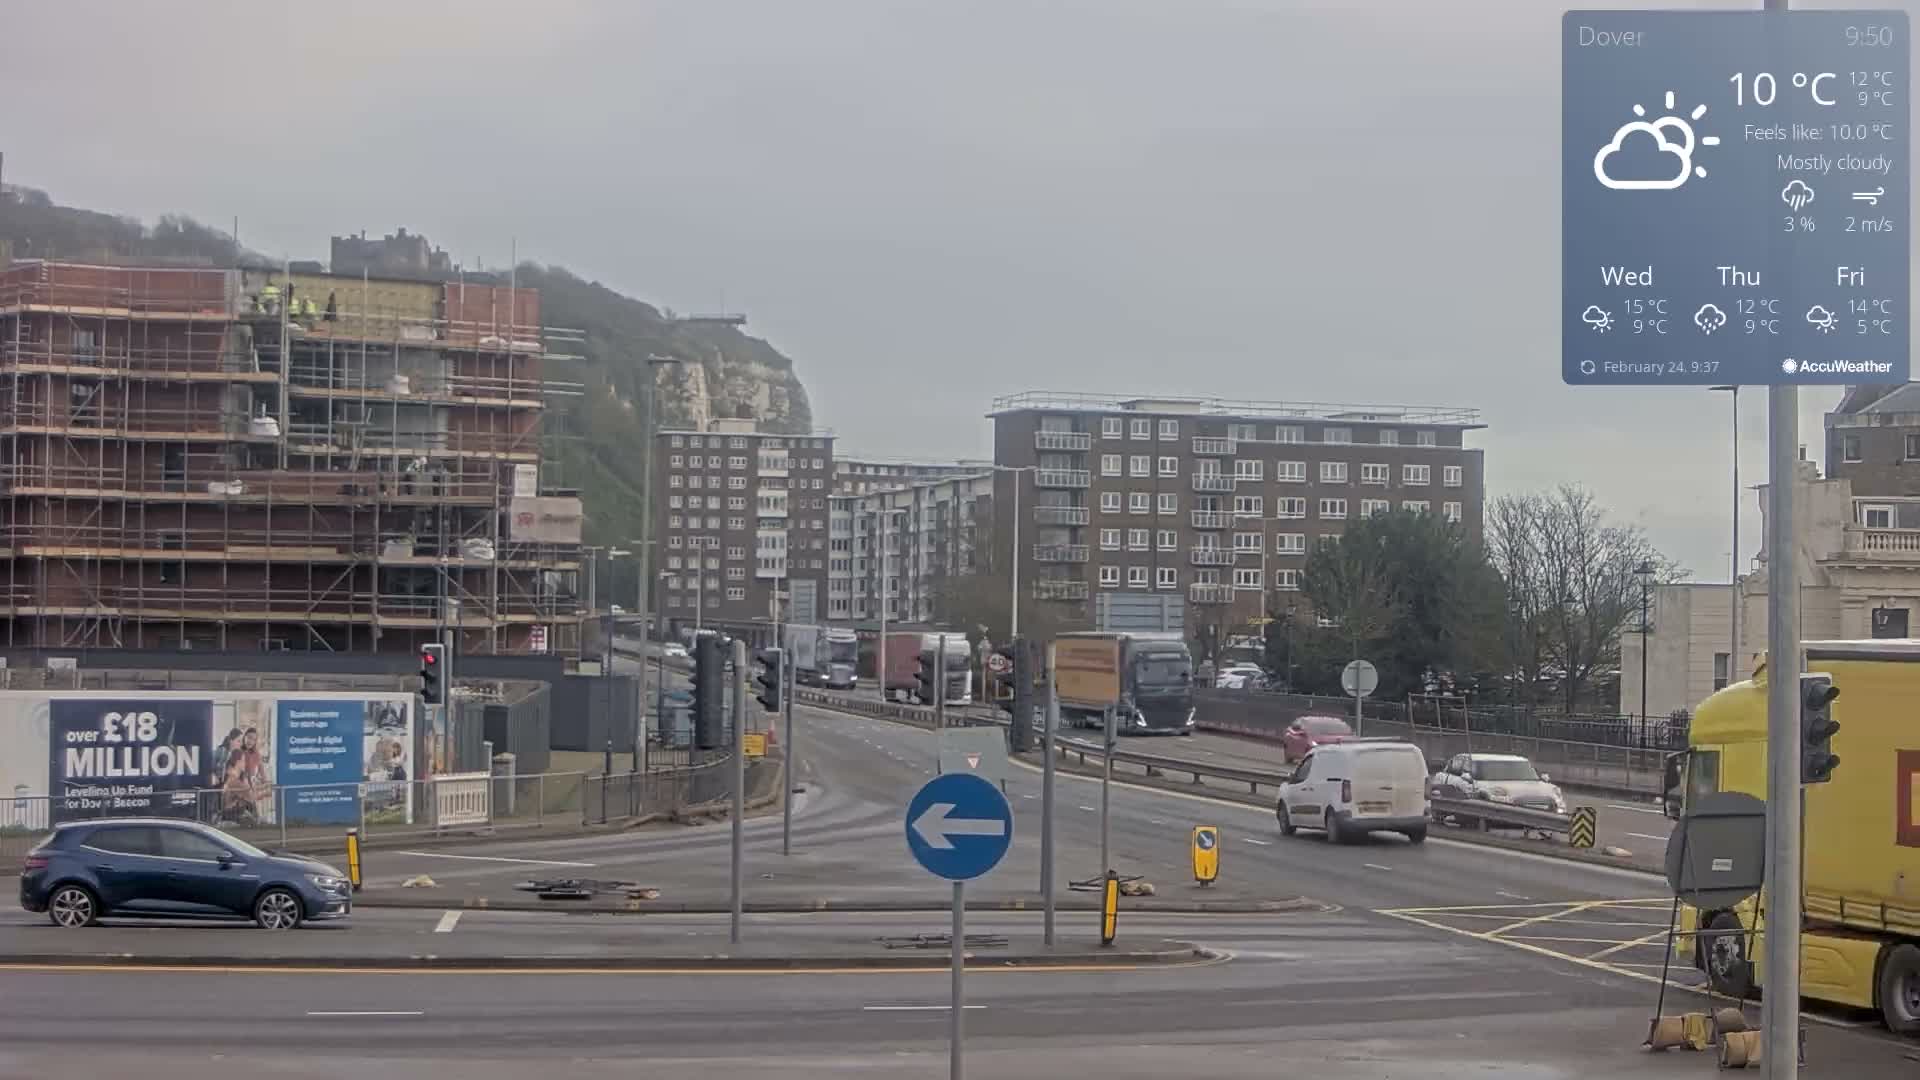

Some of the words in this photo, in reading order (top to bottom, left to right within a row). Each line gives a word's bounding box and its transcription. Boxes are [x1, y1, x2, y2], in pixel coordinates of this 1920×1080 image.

[66, 730, 99, 742] over
[104, 711, 158, 742] £18
[66, 745, 200, 778] MILLION
[65, 786, 108, 799] Levelling
[111, 786, 126, 798] Up
[128, 785, 153, 796] Fund
[81, 798, 111, 809] Dovr
